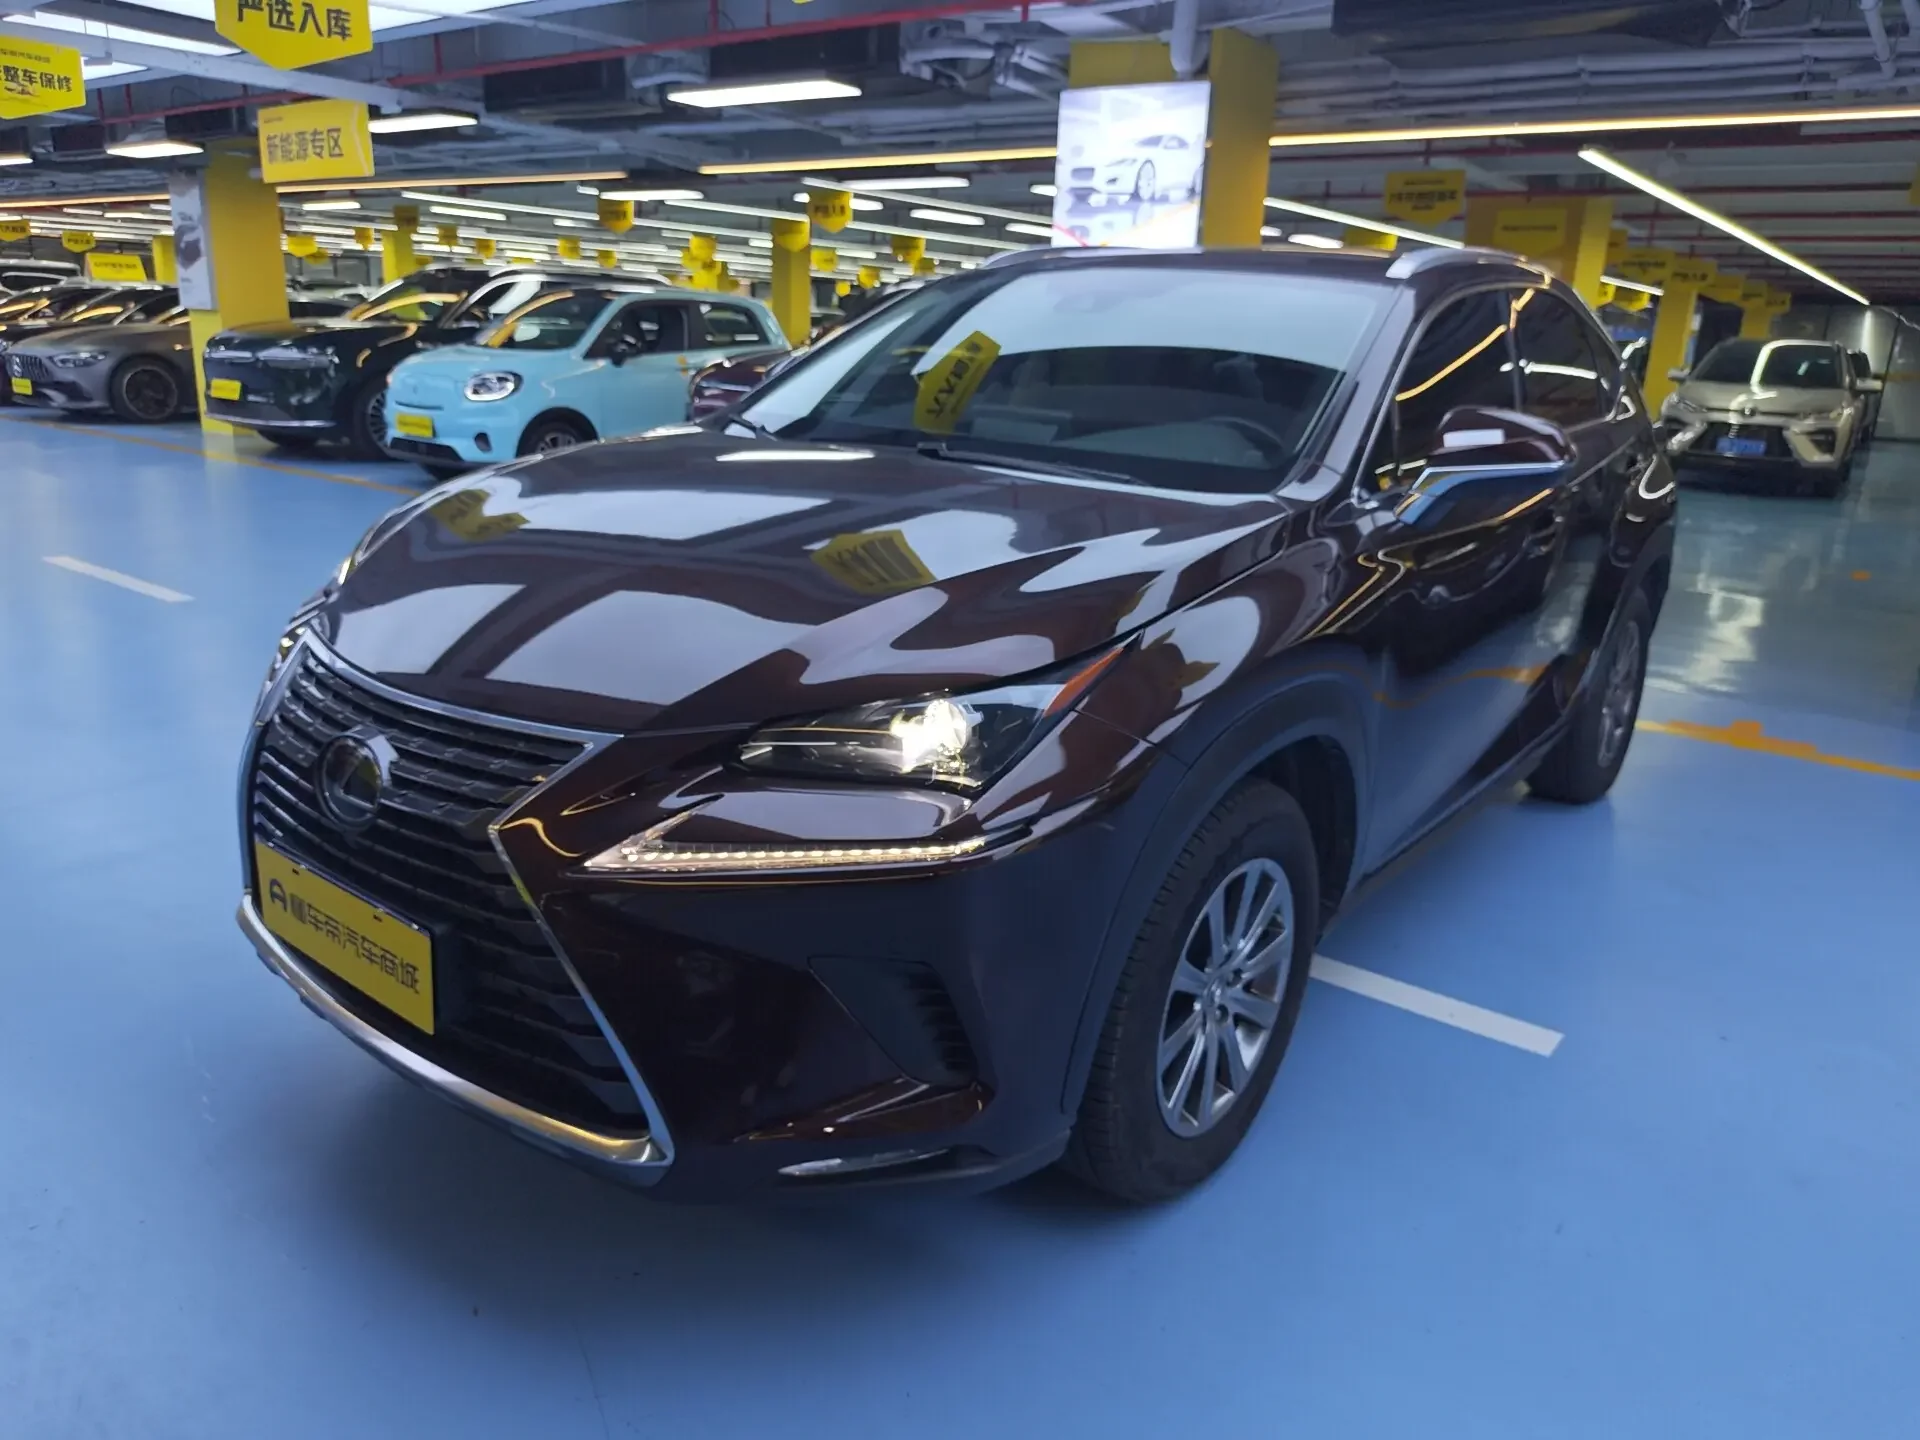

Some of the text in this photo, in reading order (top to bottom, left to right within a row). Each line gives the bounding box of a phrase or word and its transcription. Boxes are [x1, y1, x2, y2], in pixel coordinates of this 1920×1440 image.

[237, 0, 353, 41] 严选入库
[0, 65, 72, 93] 整车保修
[266, 127, 345, 165] 新能源专区
